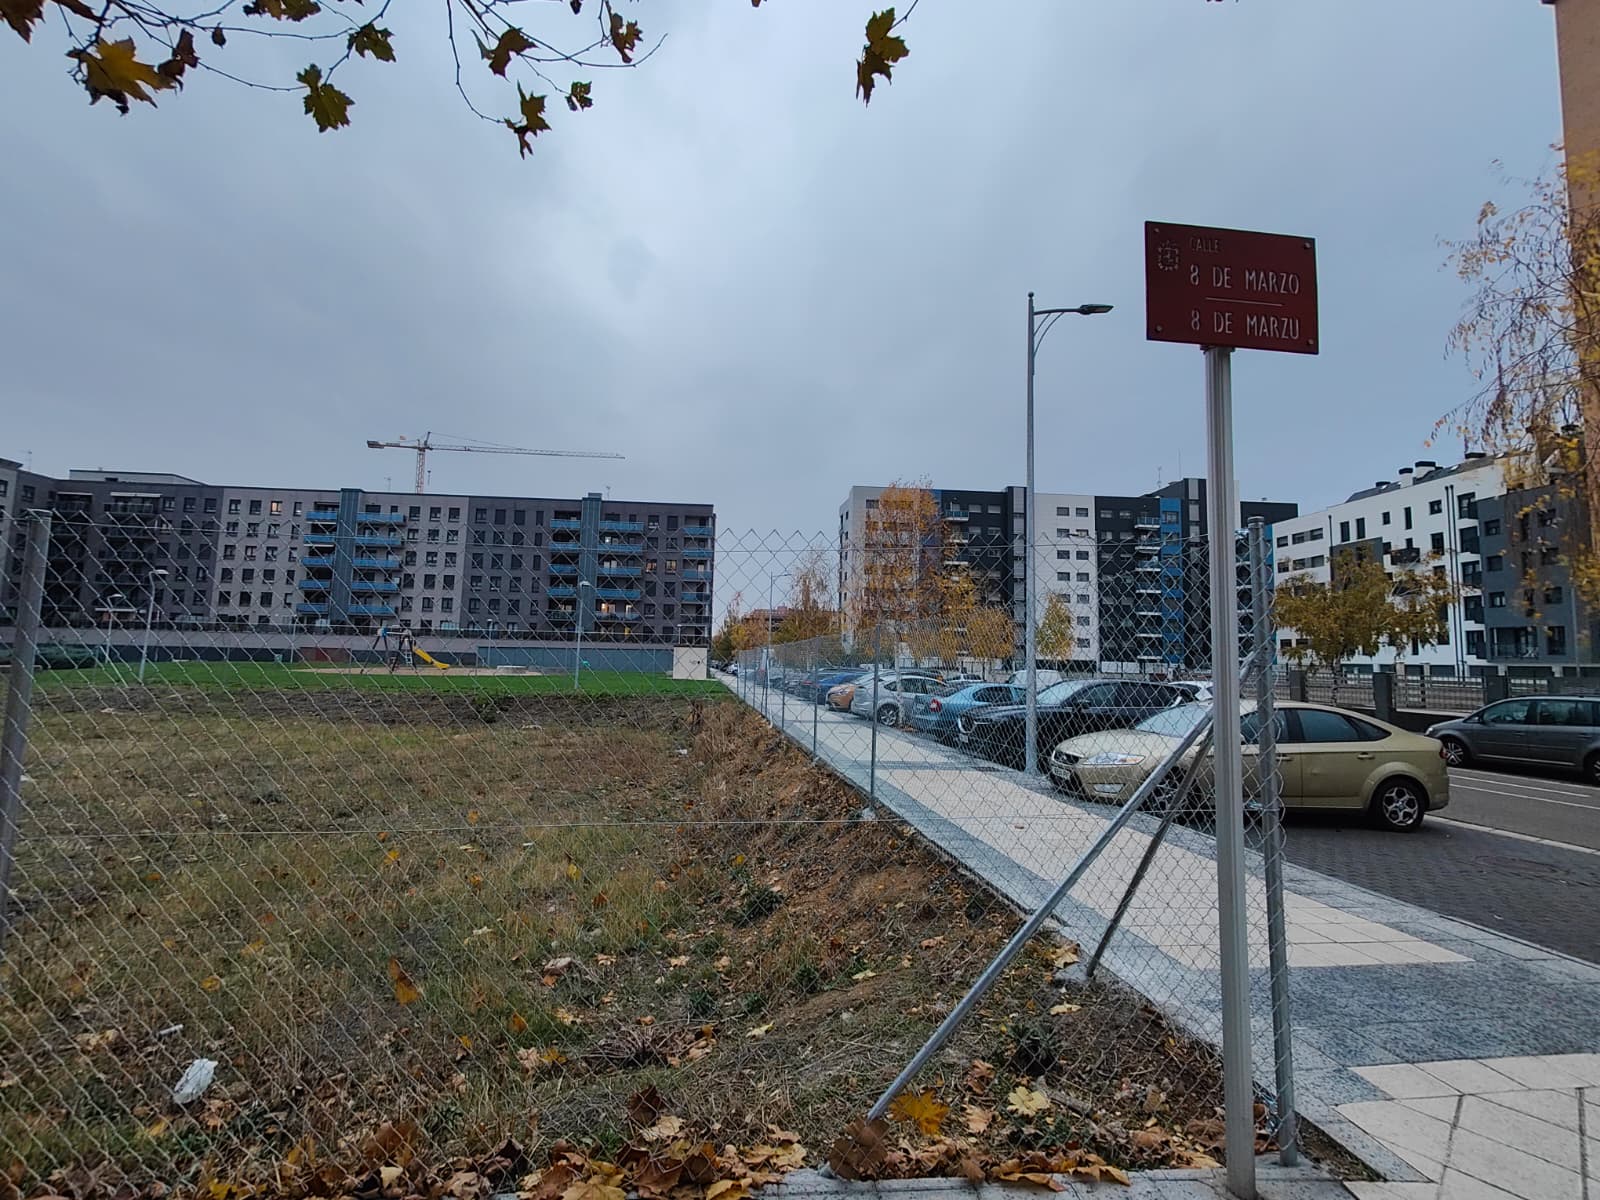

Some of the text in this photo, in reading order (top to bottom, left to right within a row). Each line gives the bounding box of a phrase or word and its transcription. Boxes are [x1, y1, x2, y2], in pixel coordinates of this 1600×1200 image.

[1190, 237, 1220, 253] CALLE
[1190, 264, 1300, 295] 8 DE MARZO
[1191, 310, 1300, 340] 8 DE MARZU
